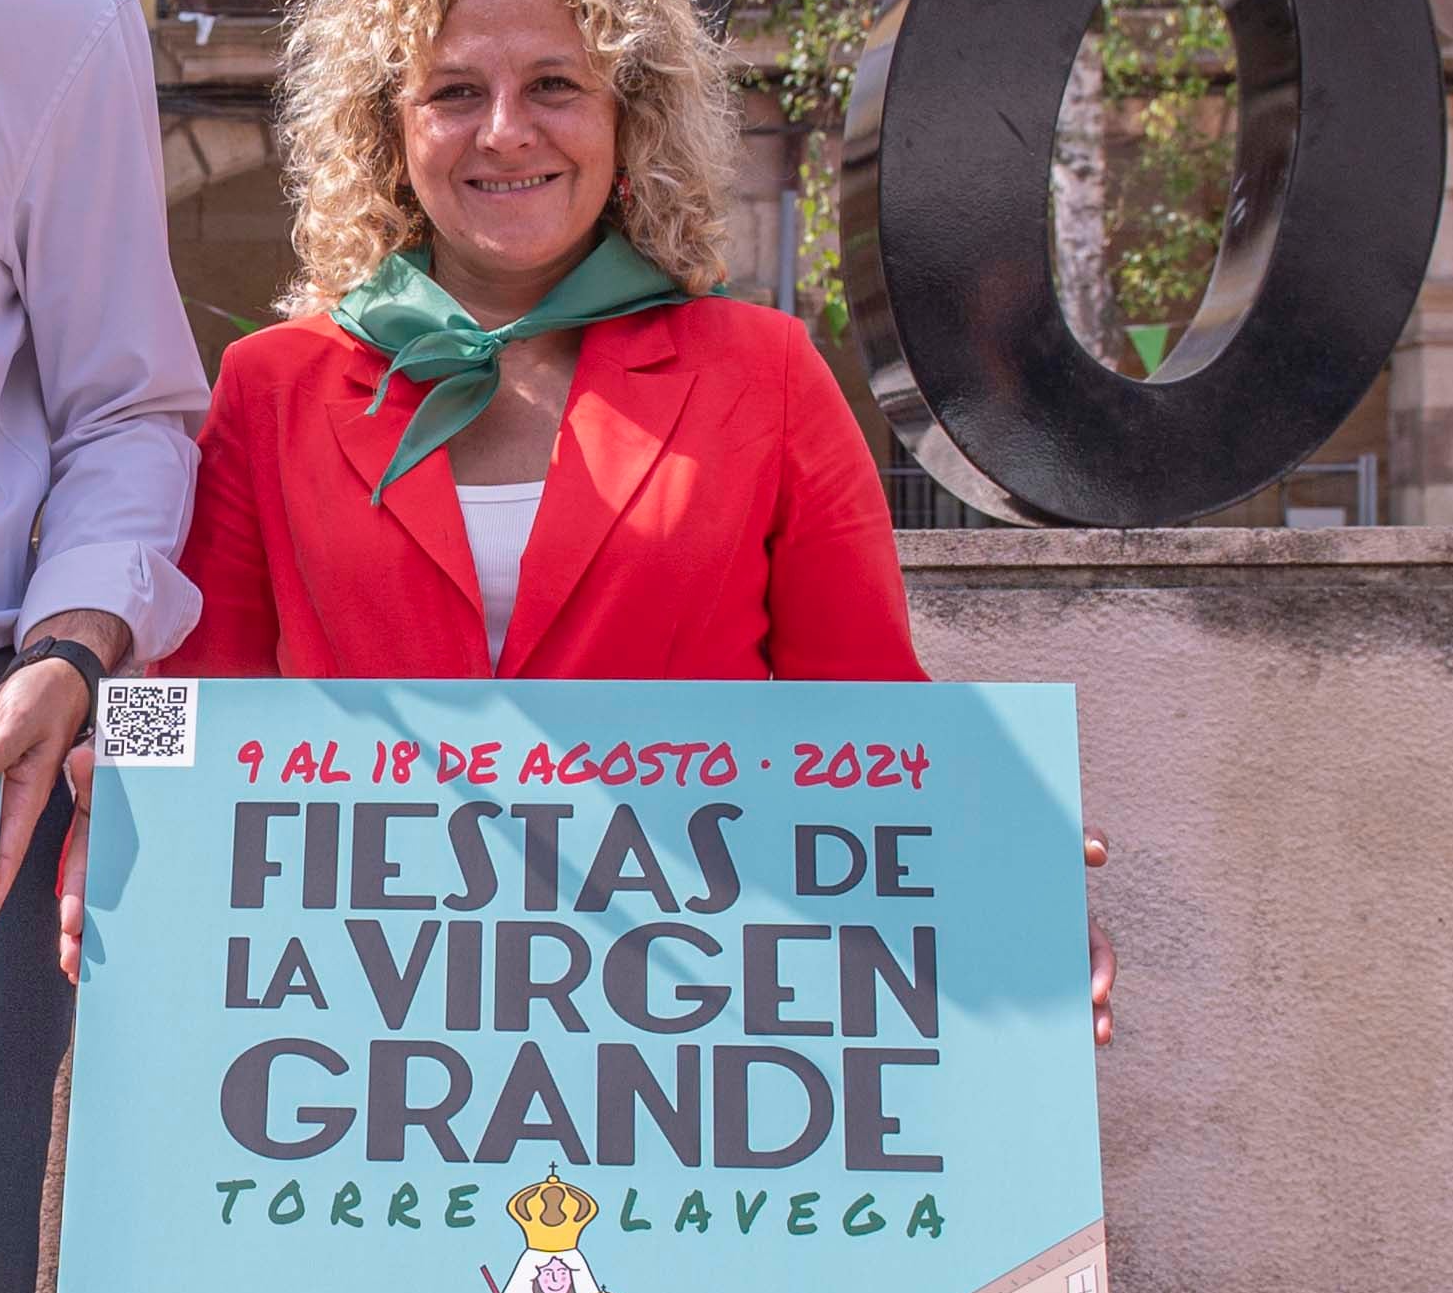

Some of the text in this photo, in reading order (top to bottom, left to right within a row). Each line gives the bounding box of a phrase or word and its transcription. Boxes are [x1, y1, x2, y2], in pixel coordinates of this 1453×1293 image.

[237, 739, 930, 790] 9 AL 18 DE AGOSTO 2024
[229, 799, 936, 916] FIESTAS DE
[224, 918, 940, 1040] LA VIRGEN
[219, 1036, 945, 1174] GRANDE
